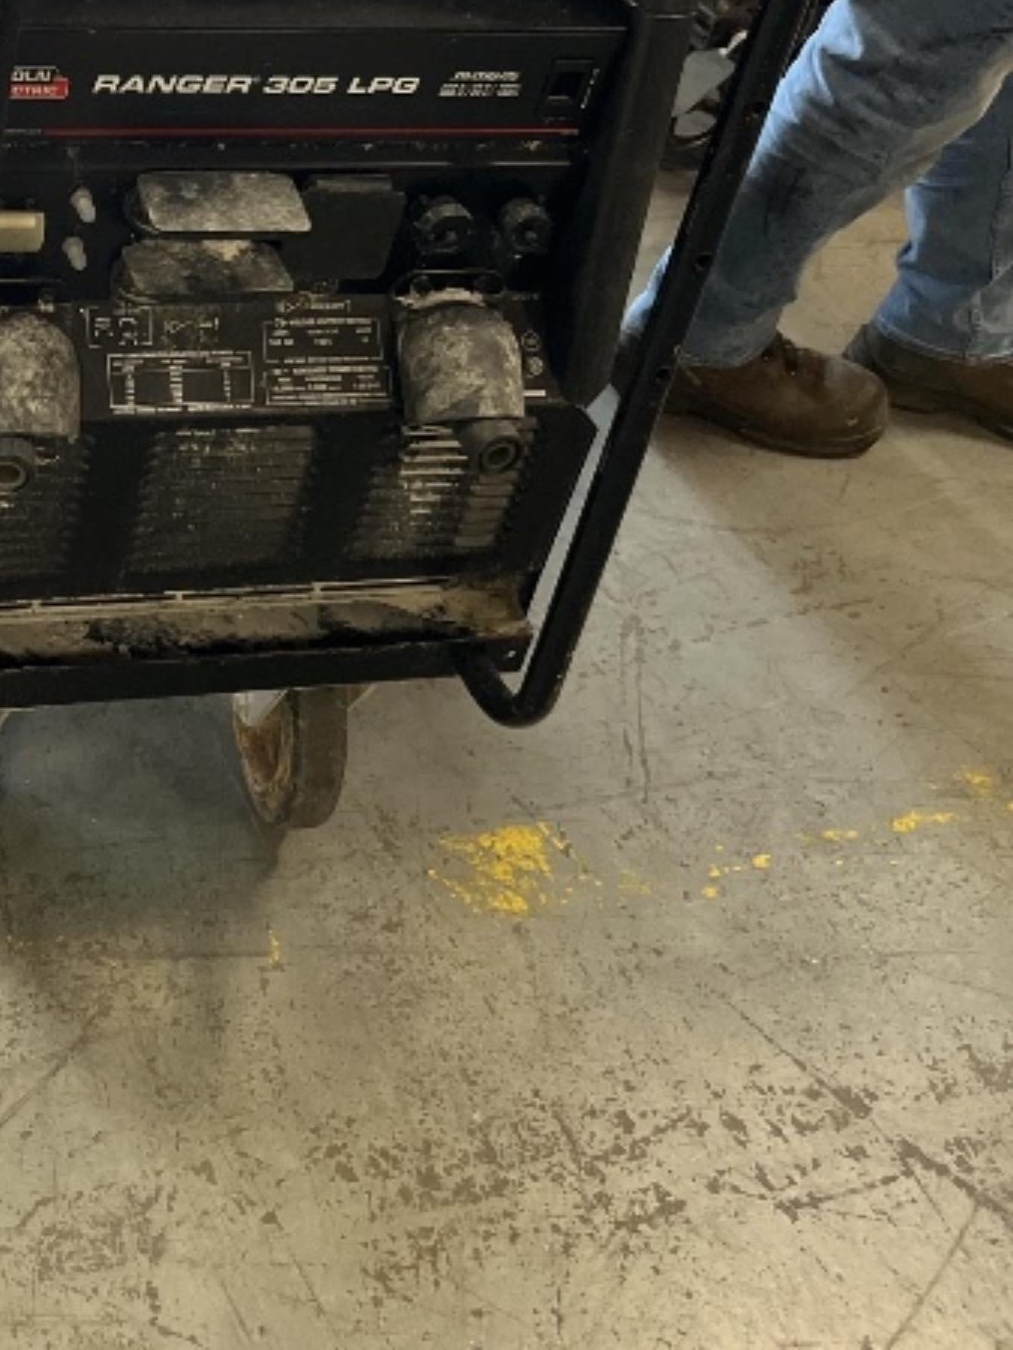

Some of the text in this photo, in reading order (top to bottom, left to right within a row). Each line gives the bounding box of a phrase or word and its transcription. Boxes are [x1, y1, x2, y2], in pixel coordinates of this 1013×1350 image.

[91, 74, 254, 95] RANGER
[262, 77, 340, 95] 305
[346, 76, 421, 95] LPG
